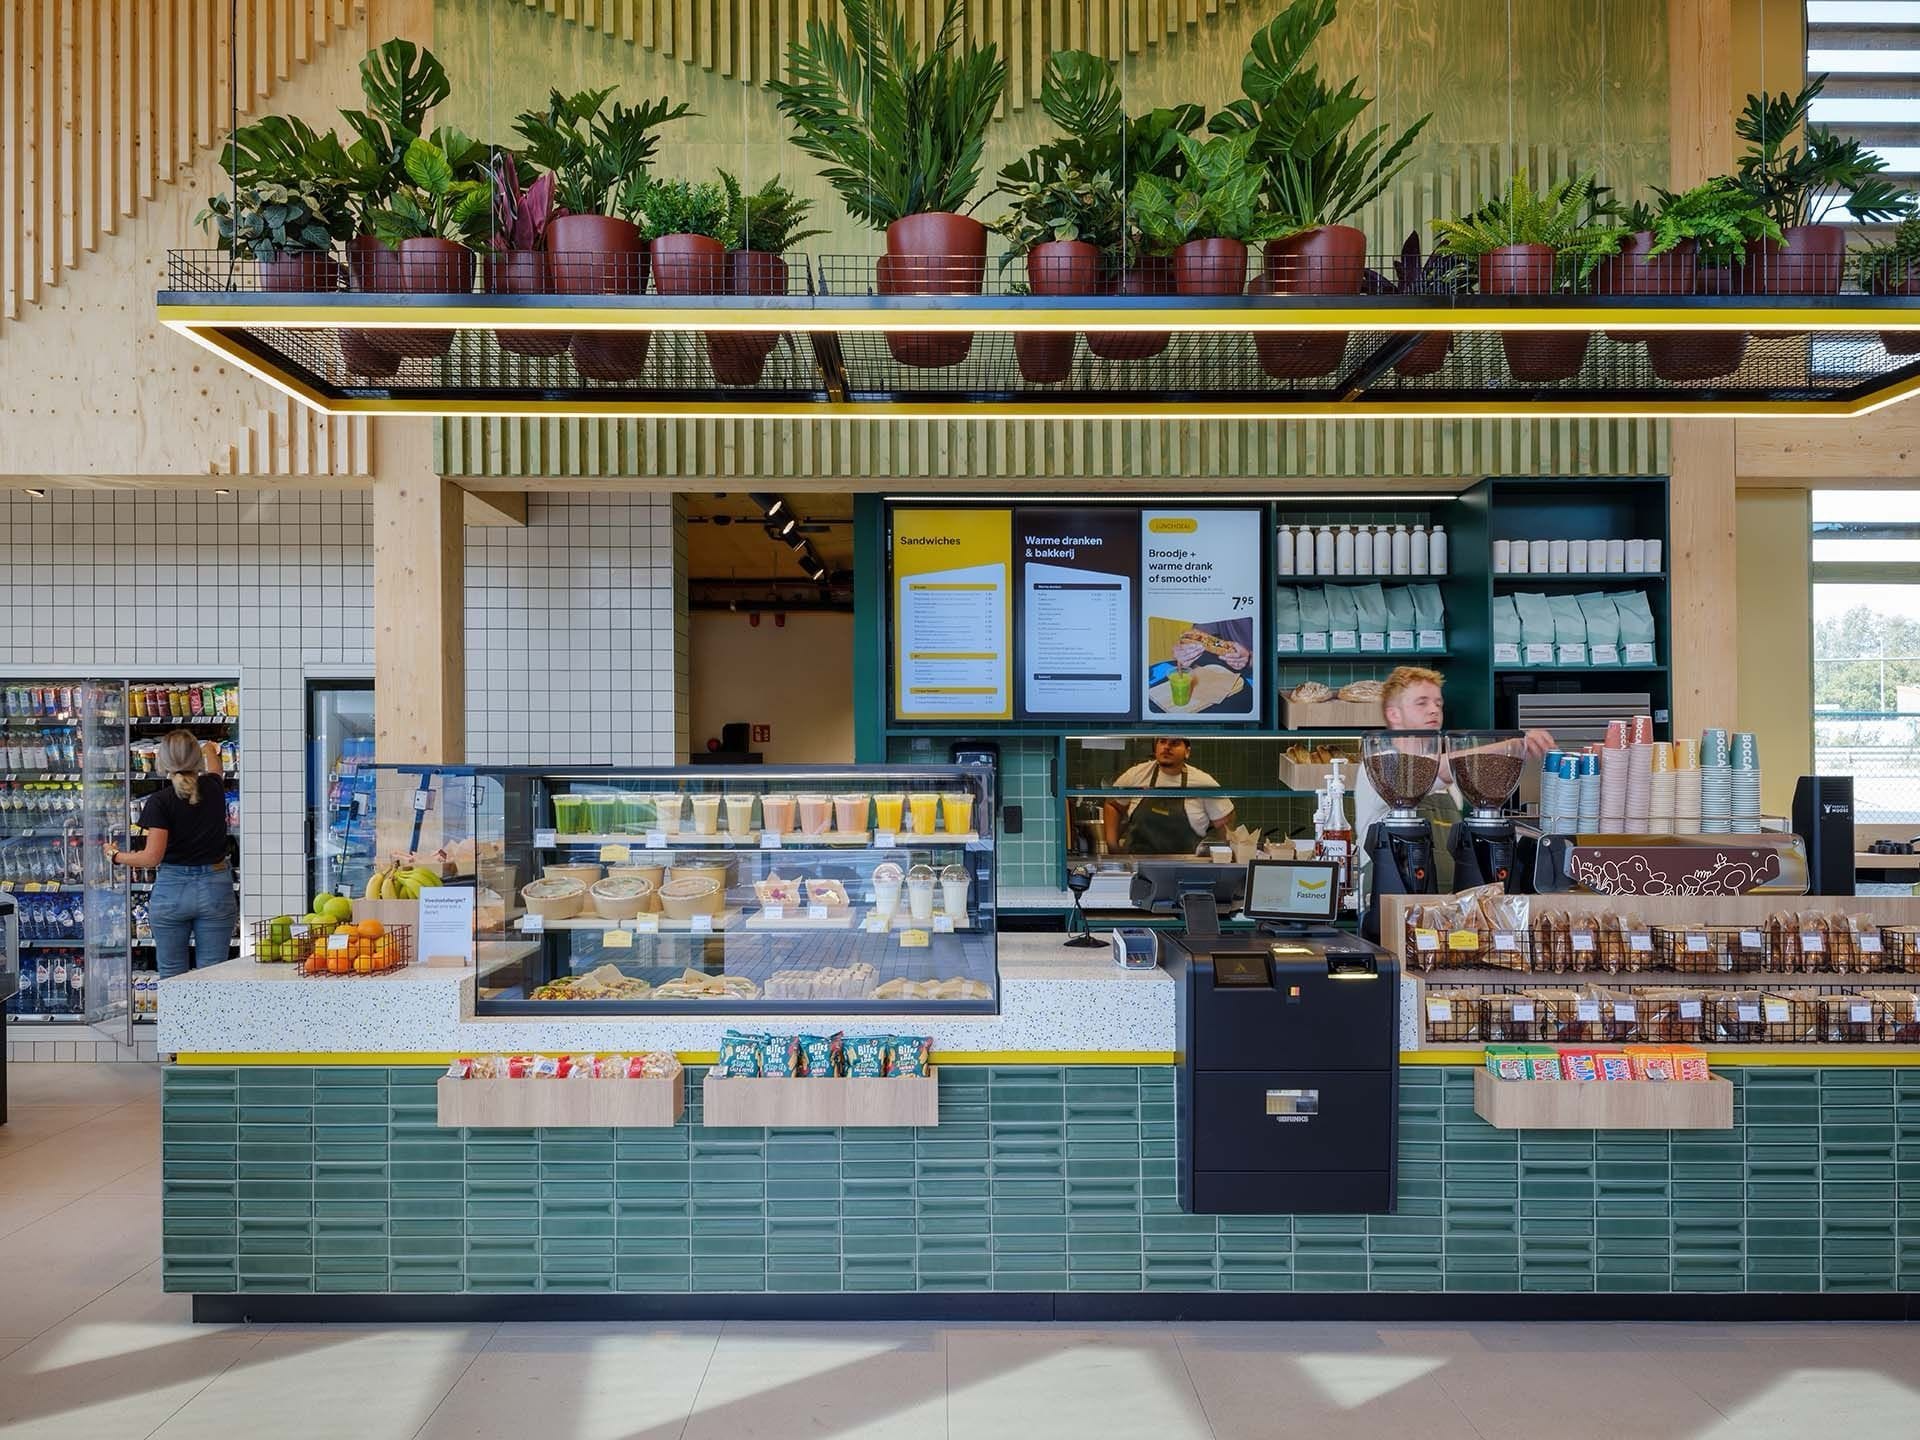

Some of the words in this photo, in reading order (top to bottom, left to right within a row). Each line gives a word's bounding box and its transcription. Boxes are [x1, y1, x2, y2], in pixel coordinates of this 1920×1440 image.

[900, 536, 961, 546] Sandwiches
[1024, 535, 1061, 546] Warme
[1061, 535, 1103, 546] dranken
[1025, 548, 1033, 558] &
[1034, 548, 1076, 560] bakkerij
[1148, 548, 1188, 560] Broodje
[1148, 563, 1183, 571] warme
[1184, 561, 1213, 571] drank
[1148, 574, 1160, 583] of
[1619, 722, 1627, 750] BOCCA
[1634, 718, 1644, 744] BOCCA
[1716, 730, 1727, 768] BOCCA
[1742, 734, 1753, 772] BOCCA
[1569, 758, 1577, 780] BOCCA
[1297, 891, 1327, 900] Fastned
[735, 1045, 755, 1053] BITES
[766, 1044, 786, 1055] BITES
[857, 1044, 878, 1055] BITES
